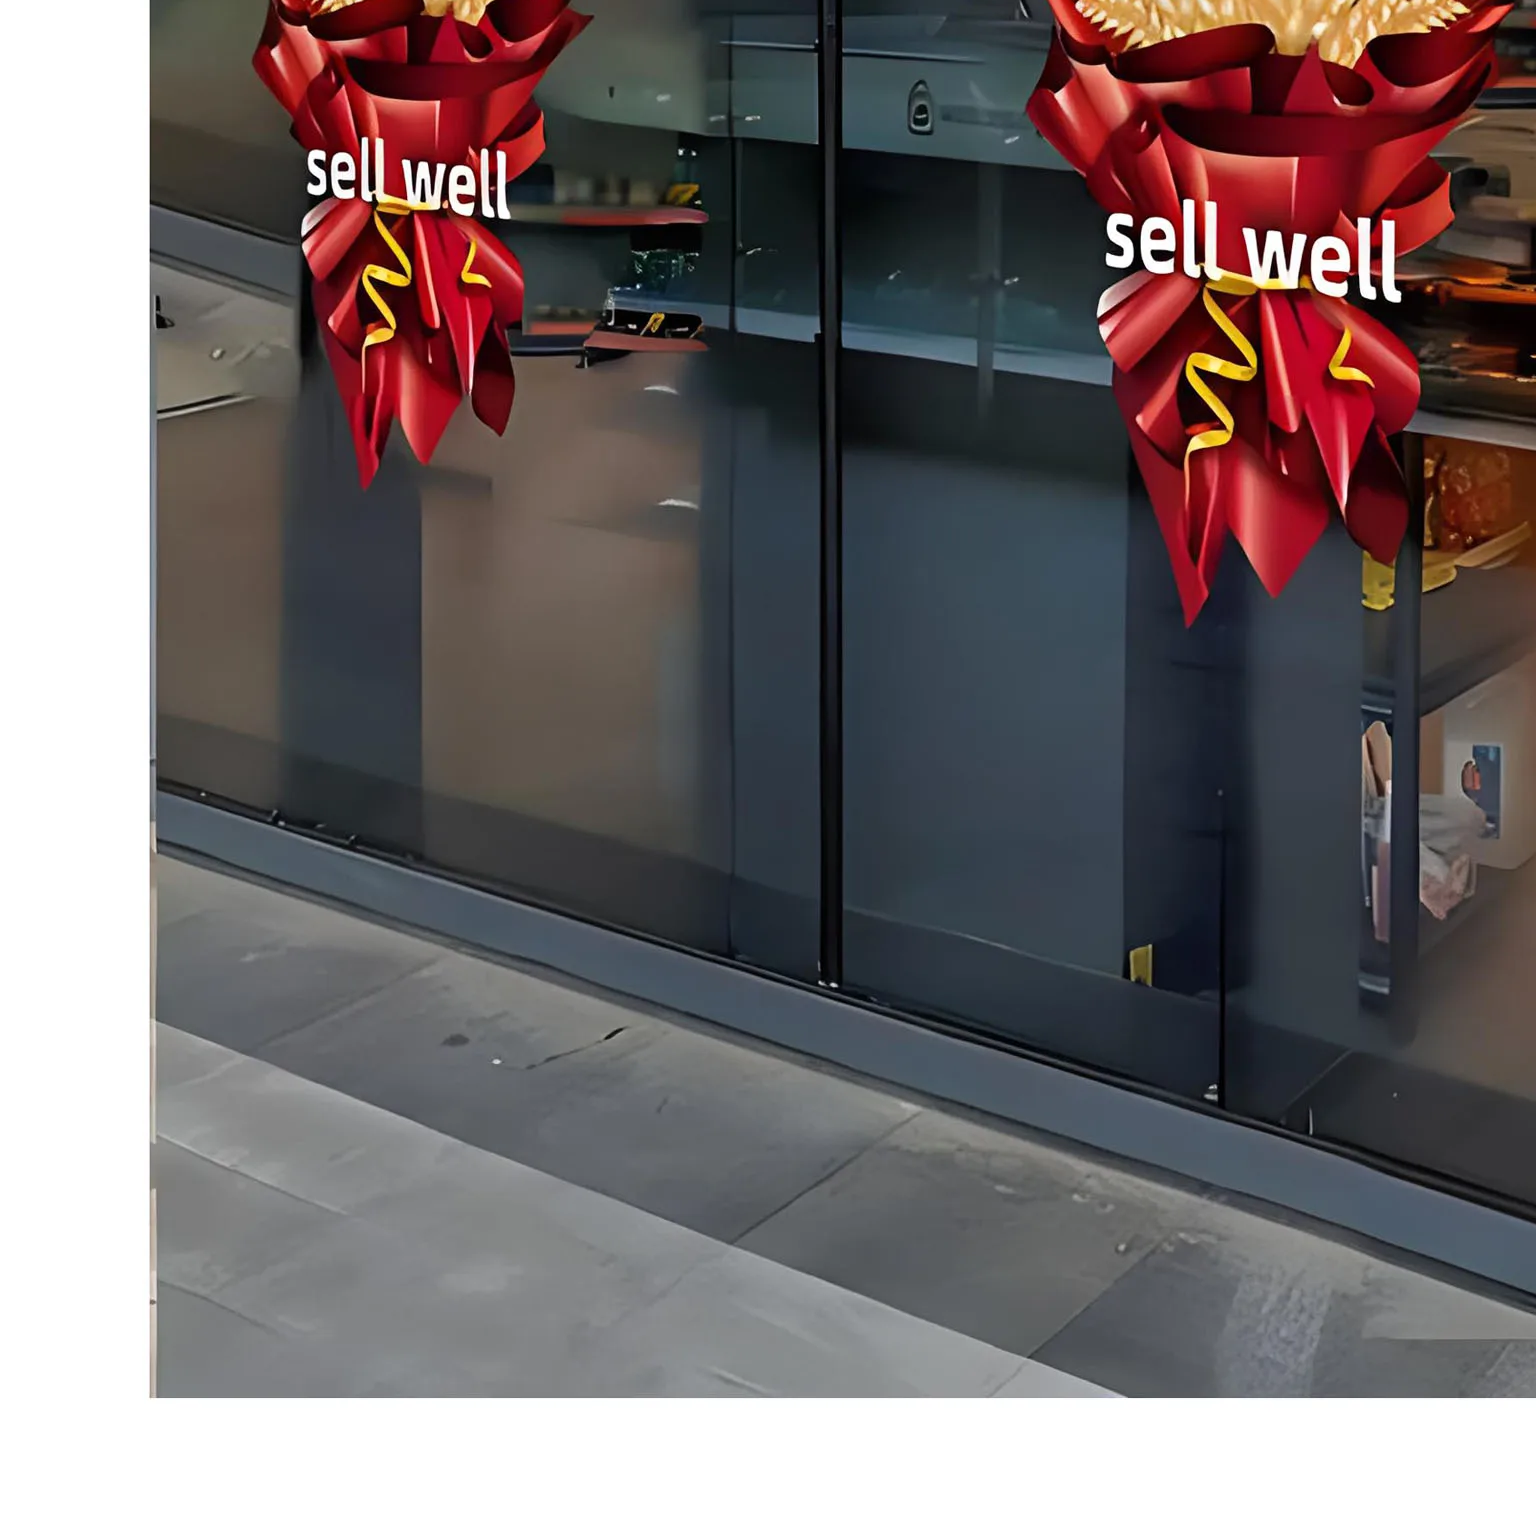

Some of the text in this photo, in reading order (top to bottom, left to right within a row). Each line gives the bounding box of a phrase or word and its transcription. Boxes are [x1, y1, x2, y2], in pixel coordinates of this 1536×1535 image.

[307, 136, 511, 220] sell well
[1105, 198, 1402, 303] sell well
